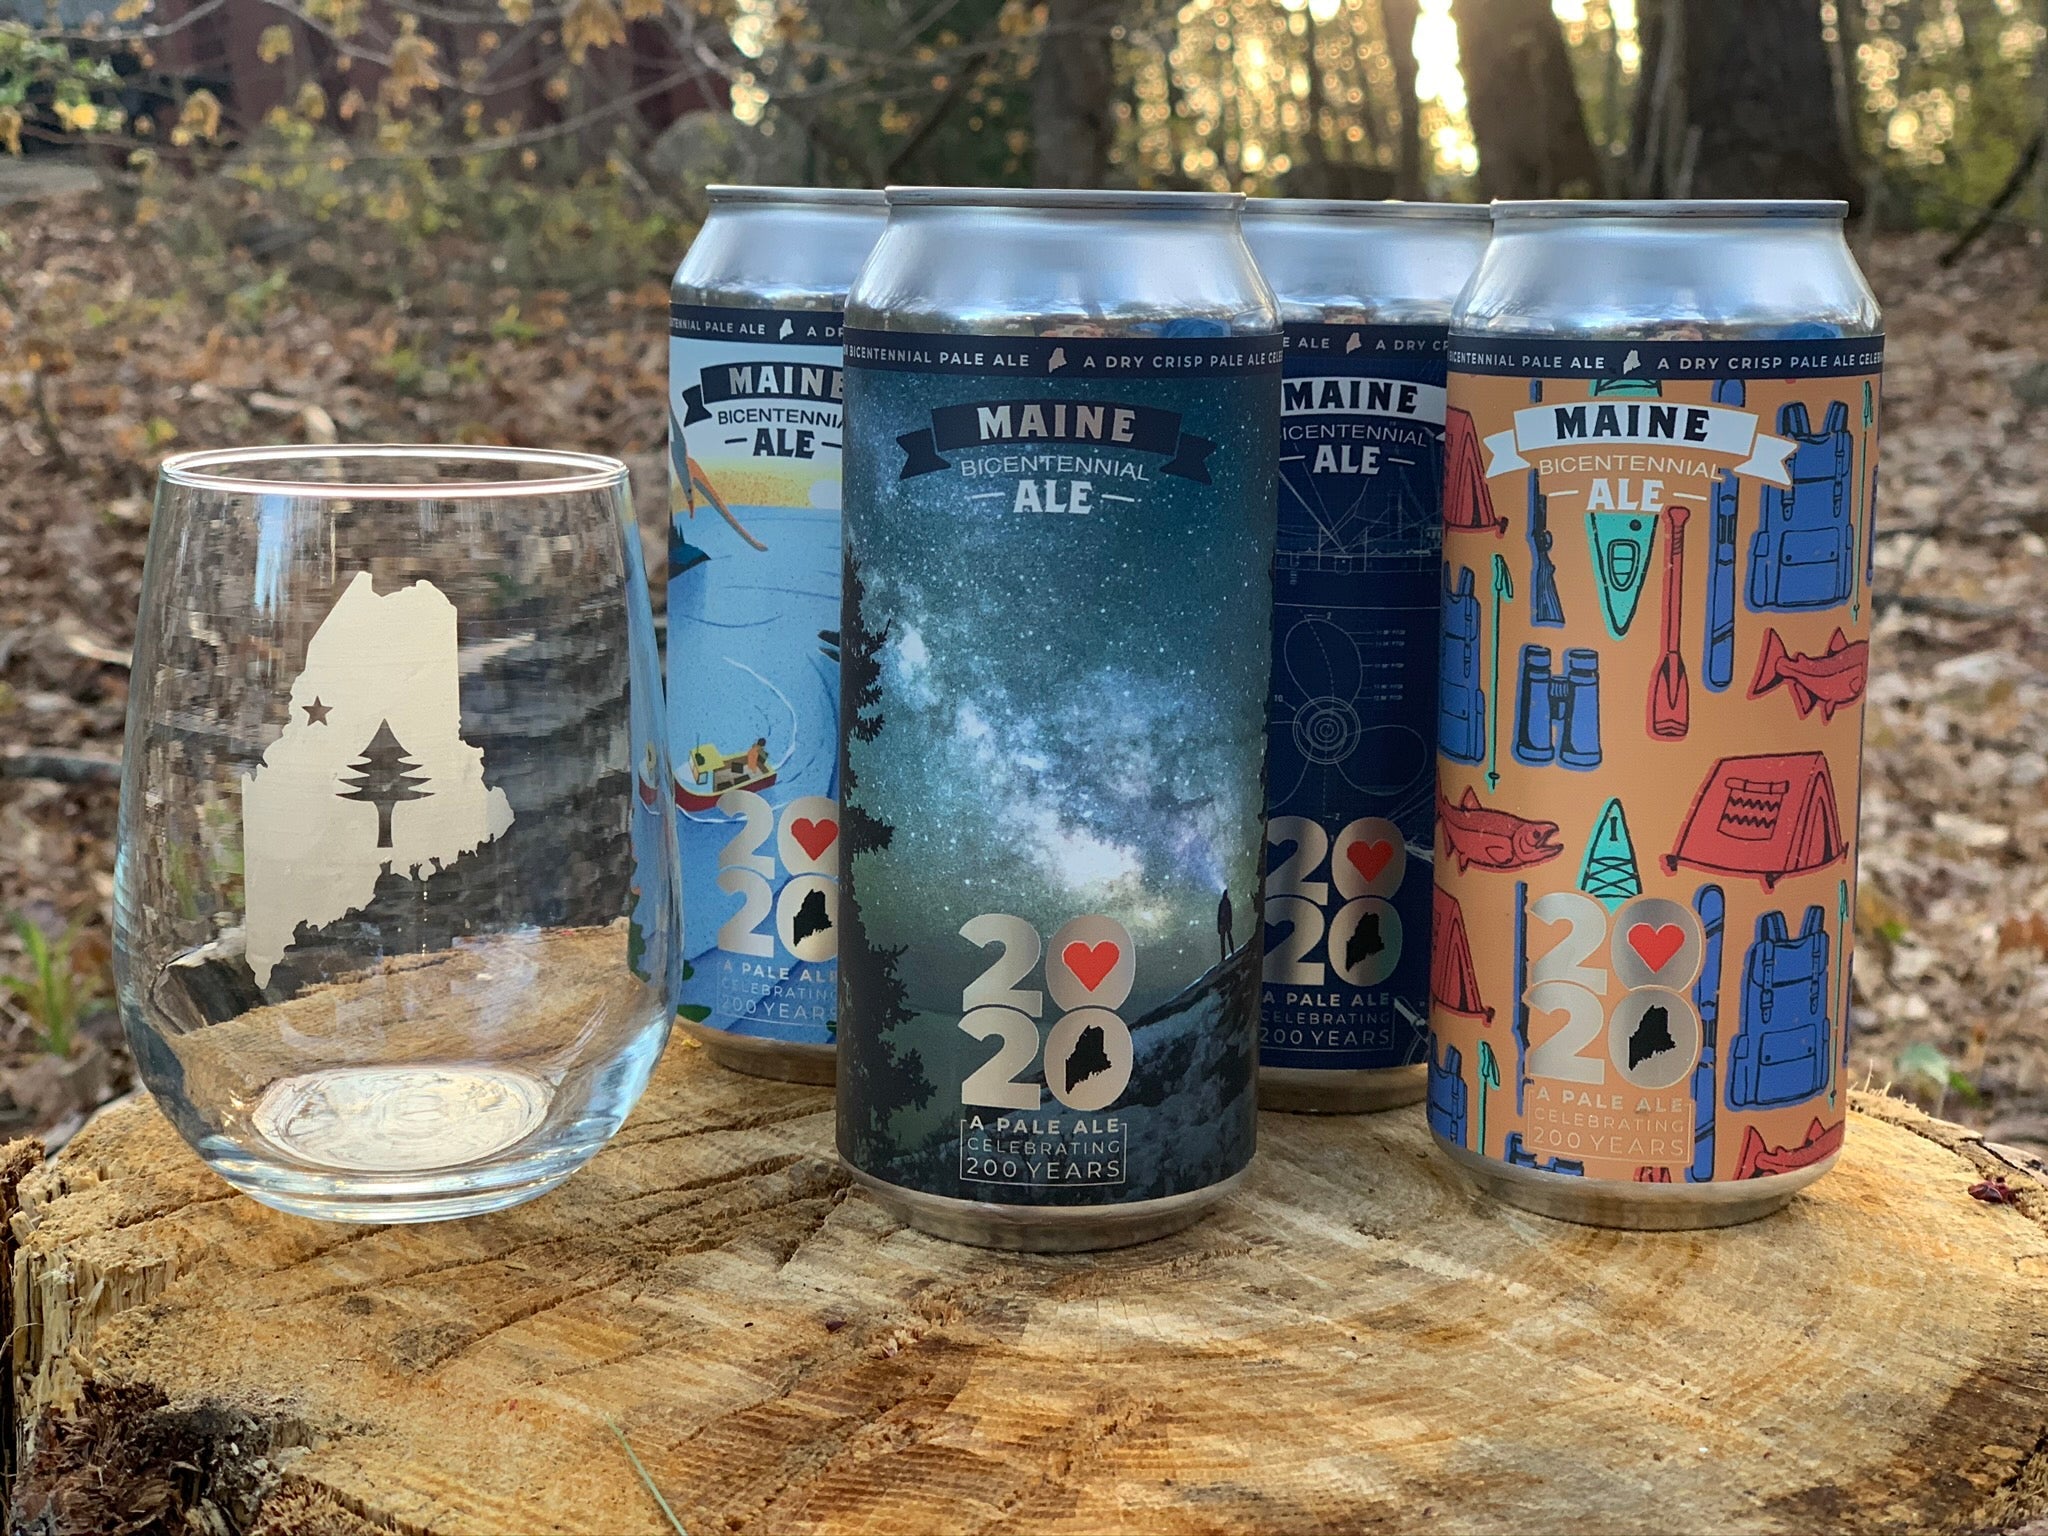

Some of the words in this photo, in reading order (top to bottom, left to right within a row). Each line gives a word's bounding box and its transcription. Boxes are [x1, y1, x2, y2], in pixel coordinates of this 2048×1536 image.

[705, 321, 734, 333] PALE
[739, 323, 766, 335] ALE
[807, 327, 817, 337] A
[849, 344, 932, 363] BICENTENNIAL
[939, 352, 984, 366] PALE
[992, 354, 1030, 367] ALE
[1083, 356, 1096, 368] A
[1105, 356, 1144, 368] DRY
[1152, 355, 1203, 368] CRISP
[1210, 354, 1243, 367] PALE
[1248, 352, 1266, 366] ALE
[1298, 337, 1330, 349] ALE
[1376, 340, 1386, 350] A
[1394, 340, 1426, 351] DRY
[1522, 356, 1562, 368] PALE
[1570, 357, 1605, 369] ALE
[1657, 358, 1670, 370] A
[1680, 357, 1719, 370] DRY
[1728, 357, 1782, 370] CRISP
[1790, 356, 1828, 368] PALE
[1833, 354, 1855, 367] ALE
[1283, 380, 1418, 415] MAINE
[977, 404, 1136, 442] MAINE
[1281, 424, 1427, 447] ICENTENNIAL
[1554, 404, 1710, 443] MAINE
[752, 428, 815, 459] ALE
[961, 455, 1149, 481] BICENTENNIAL
[1312, 444, 1381, 475] ALE
[1539, 454, 1723, 481] BICENTENNIAL
[1013, 479, 1093, 515] ALE
[1586, 478, 1665, 513] ALE
[1530, 892, 1703, 996] 20
[723, 959, 733, 972] A
[742, 961, 790, 981] PALE
[958, 912, 1136, 1018] 20
[721, 995, 756, 1015] 200
[1262, 990, 1275, 1004] A
[1286, 992, 1340, 1007] PALE
[1351, 992, 1389, 1007] ALE
[1260, 1010, 1390, 1026] CELEBRATING
[1260, 1027, 1303, 1045] 200
[1311, 1029, 1389, 1046] YEARS
[1523, 981, 1699, 1090] 20
[957, 1006, 1134, 1111] 20
[1536, 1086, 1550, 1101] A
[1562, 1089, 1623, 1110] PALE
[1636, 1097, 1683, 1113] ALE
[969, 1115, 984, 1131] A
[997, 1117, 1060, 1135] PALE
[1073, 1118, 1119, 1134] ALE
[1535, 1107, 1684, 1133] CELEBRATING
[967, 1137, 1120, 1155] CELEBRATING
[1533, 1126, 1581, 1148] 200
[1590, 1135, 1684, 1156] YEARS
[967, 1157, 1017, 1178] 200
[1027, 1160, 1120, 1180] YEARS
